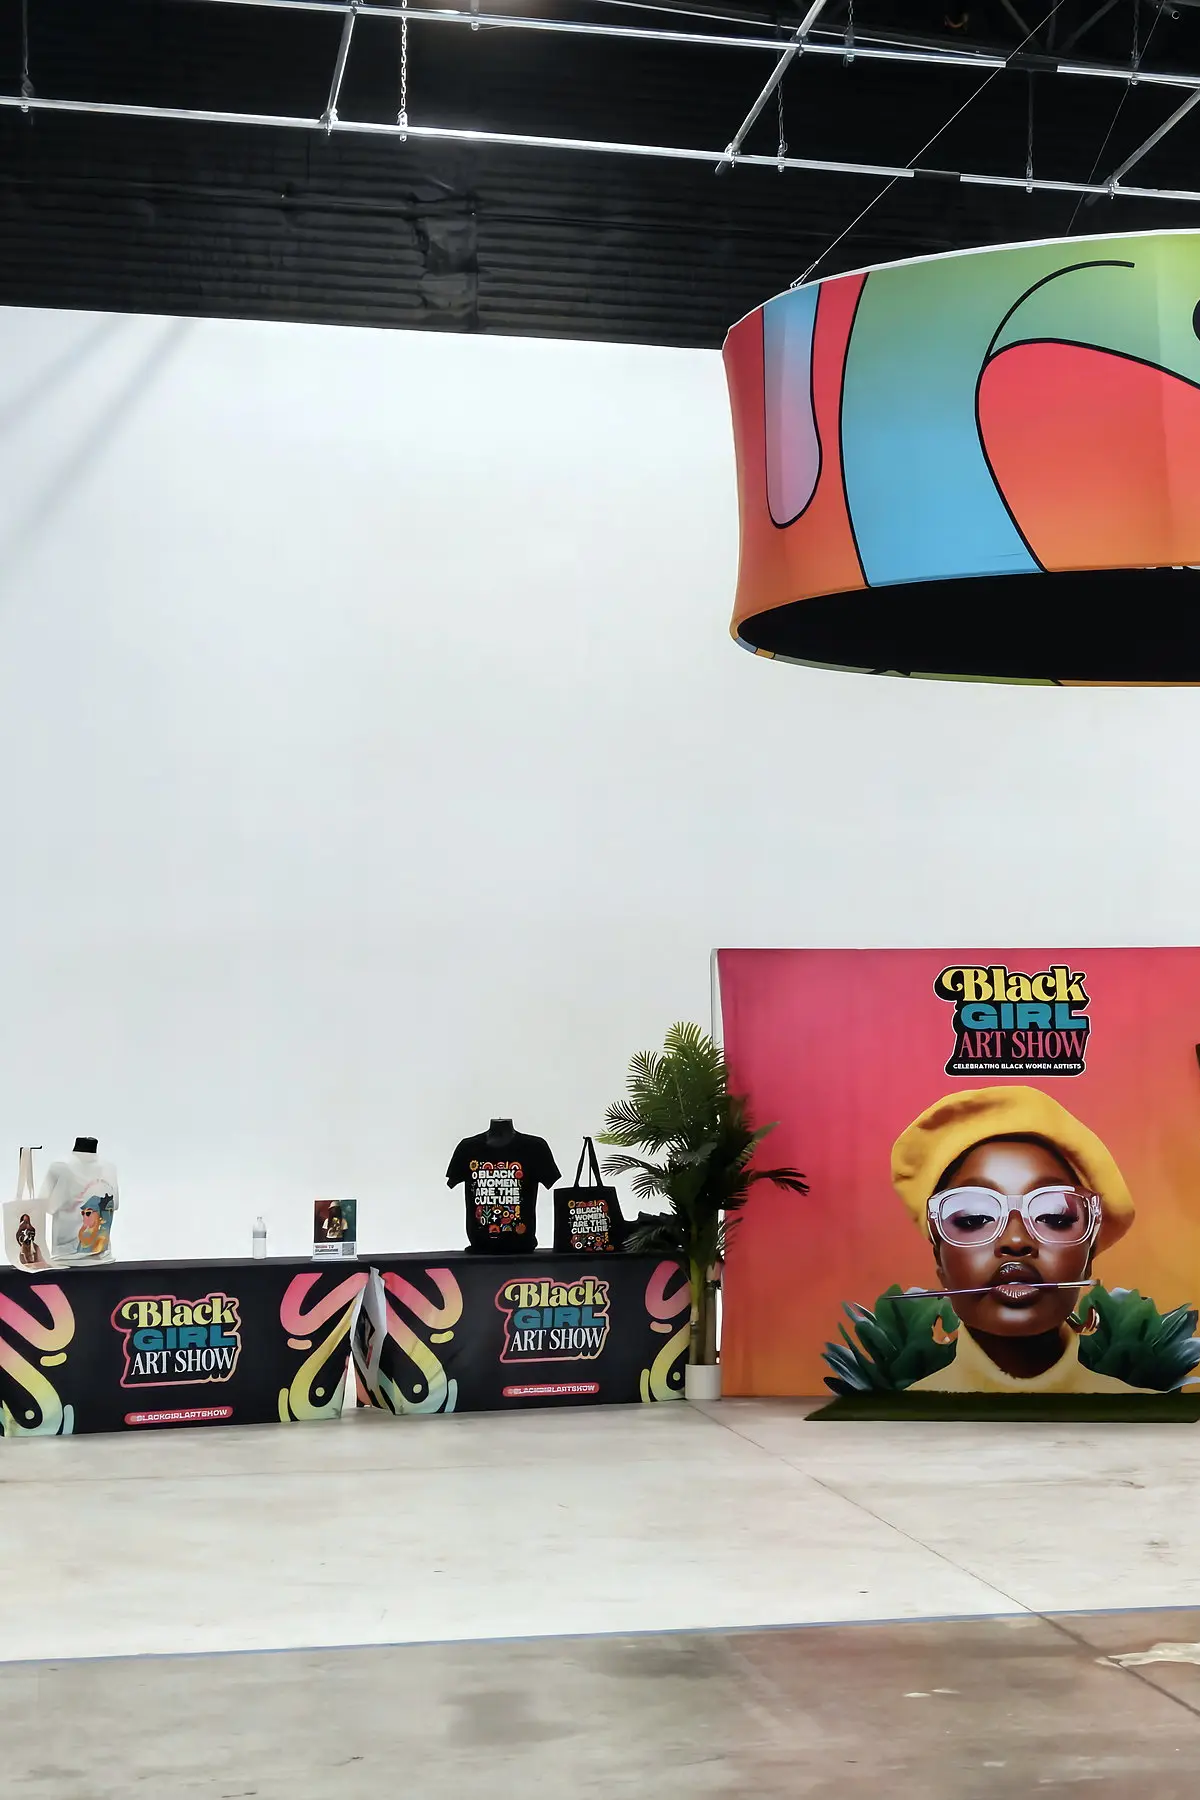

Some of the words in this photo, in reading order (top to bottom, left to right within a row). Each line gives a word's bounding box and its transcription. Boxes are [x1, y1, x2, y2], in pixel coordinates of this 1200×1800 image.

[942, 968, 1087, 1002] Black
[960, 1002, 1087, 1030] GIRL
[958, 1031, 1006, 1059] ART
[1011, 1030, 1088, 1059] SHOW
[477, 1178, 518, 1188] WOMEN
[478, 1170, 516, 1179] BLACK
[474, 1195, 520, 1205] CULTURE
[475, 1187, 496, 1197] ARE
[497, 1187, 520, 1196] THE
[574, 1212, 605, 1222] WOMEN
[575, 1206, 603, 1215] BLACK
[571, 1225, 609, 1235] CULTURE
[572, 1220, 589, 1228] ARE
[589, 1218, 608, 1227] THE
[504, 1281, 605, 1308] Black
[121, 1298, 235, 1328] Black
[513, 1306, 605, 1330] GIRL
[133, 1325, 236, 1351] GIRL
[510, 1329, 547, 1352] ART
[549, 1327, 605, 1350] SHOW
[130, 1350, 171, 1376] ART
[174, 1347, 236, 1373] SHOW
